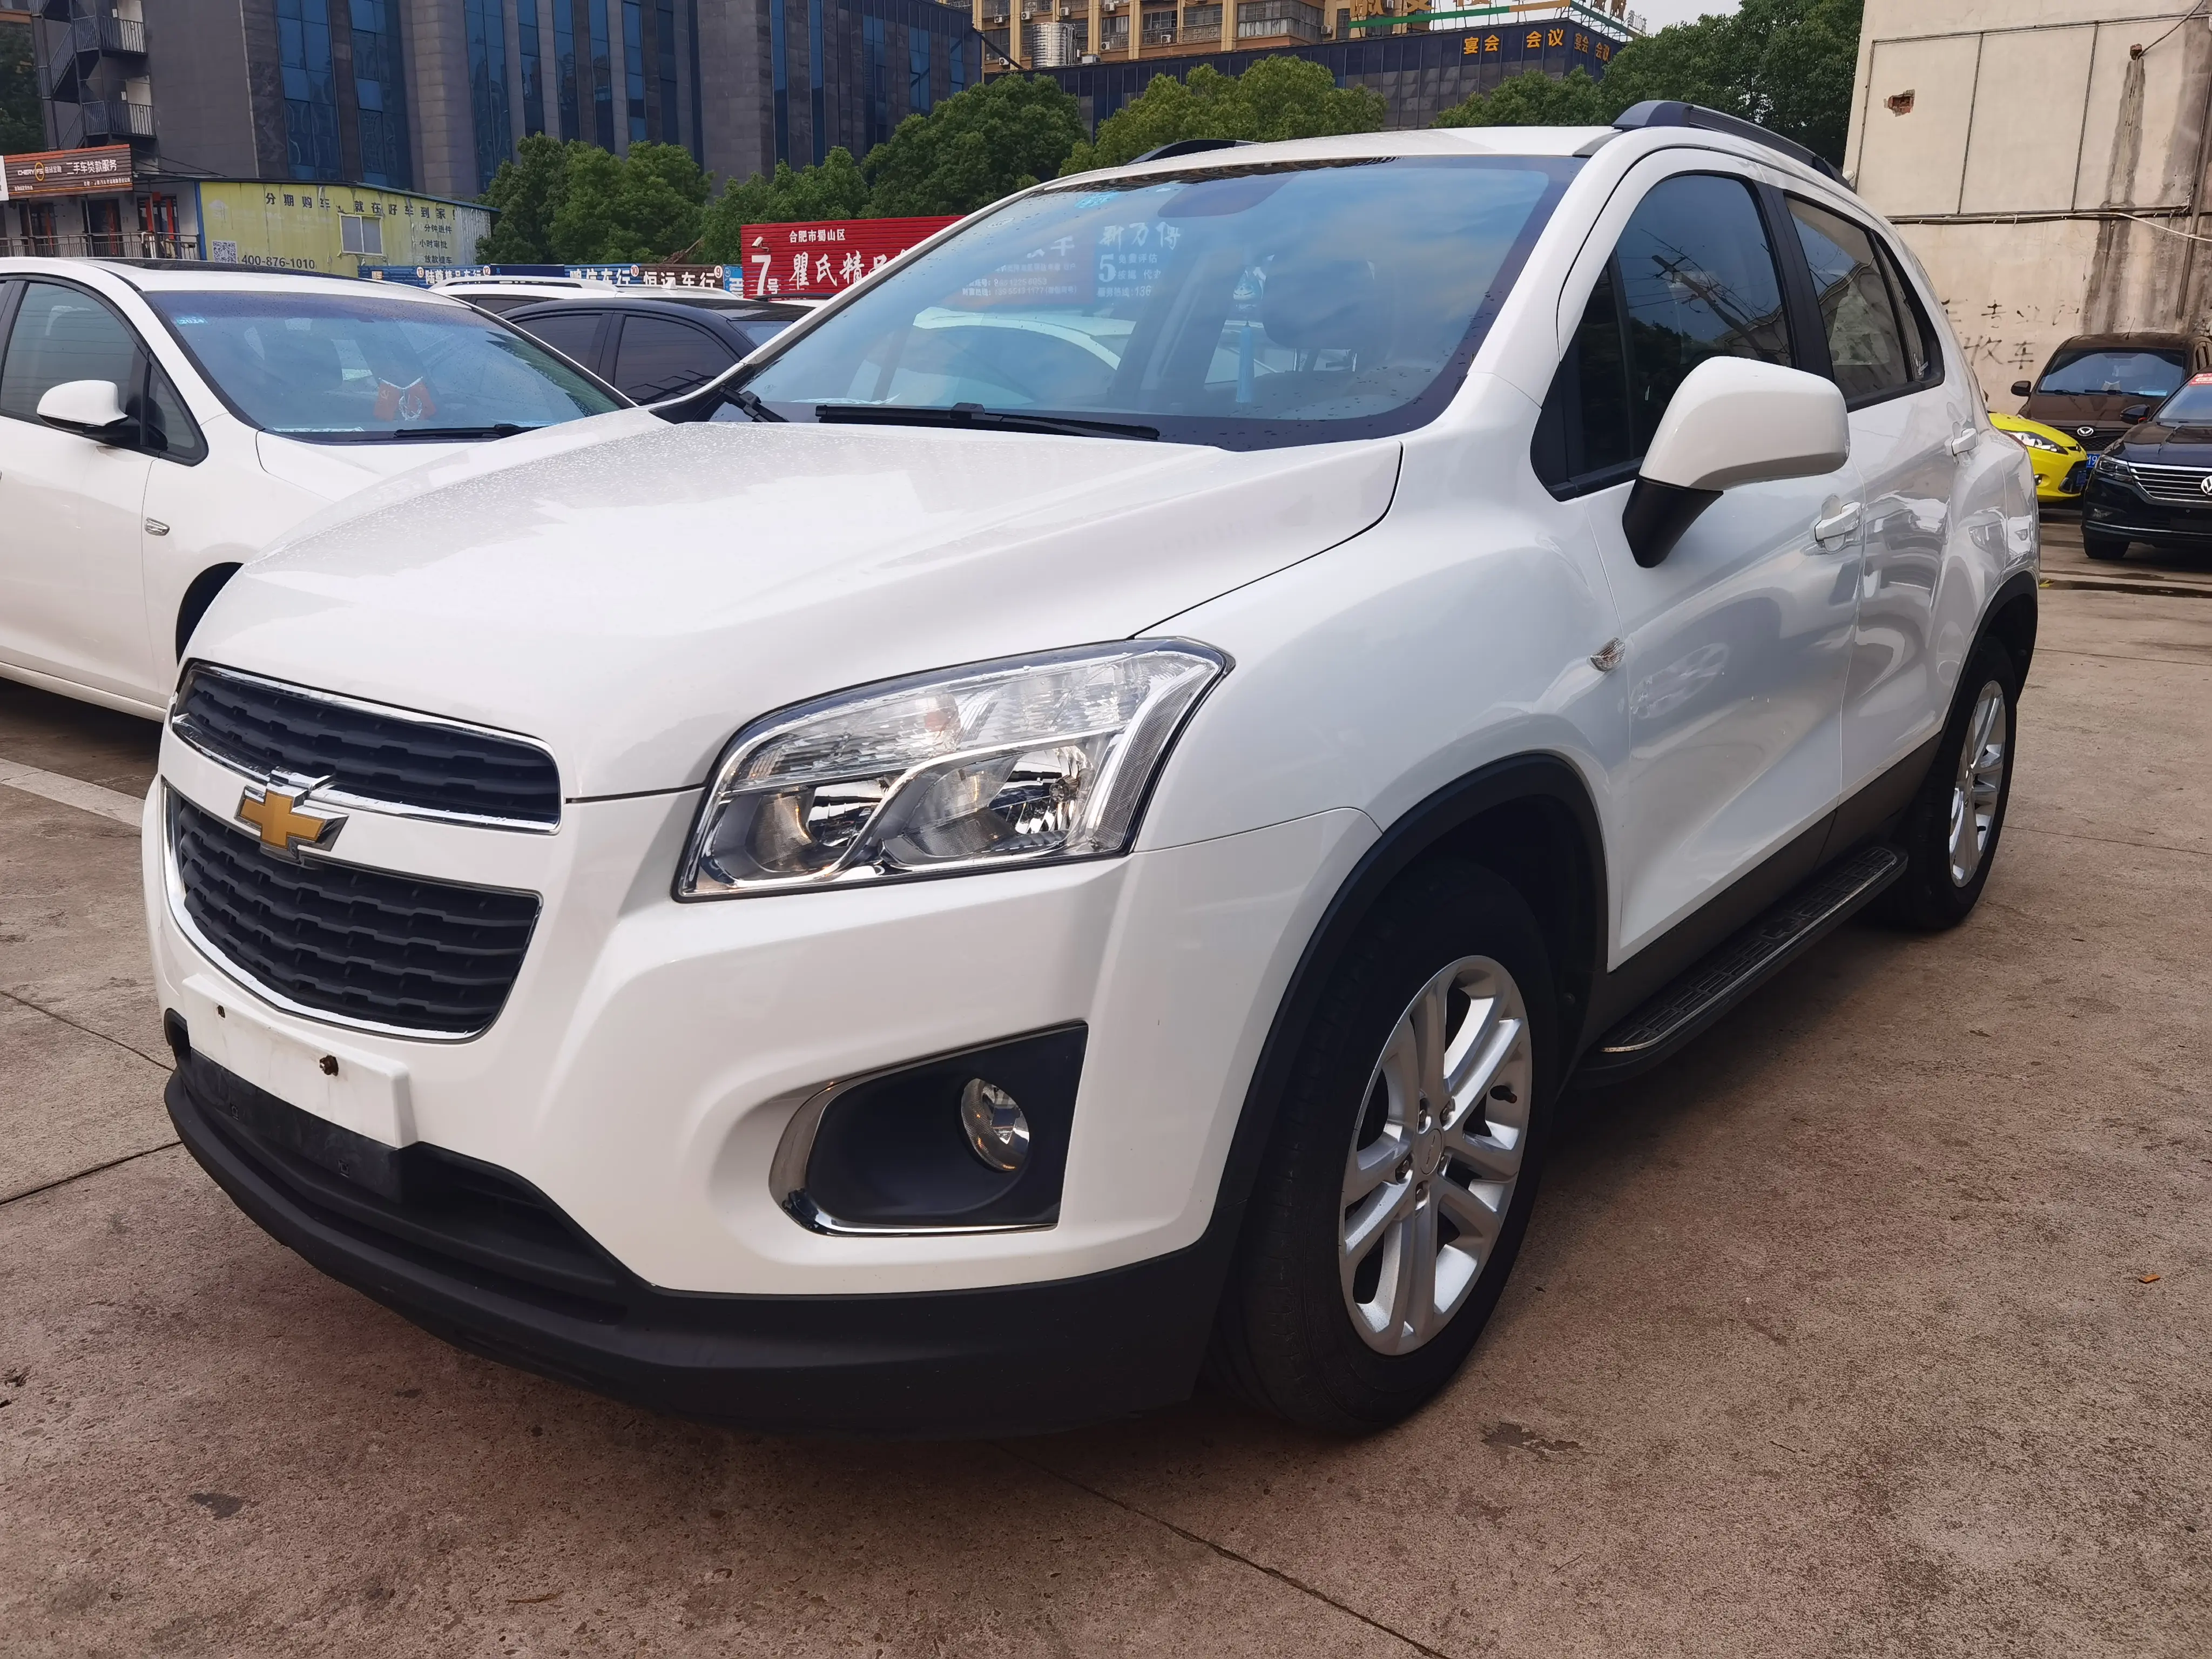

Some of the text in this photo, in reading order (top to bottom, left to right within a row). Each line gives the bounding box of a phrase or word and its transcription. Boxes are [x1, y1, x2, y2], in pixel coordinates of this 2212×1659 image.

[1463, 28, 1564, 55] 宴会 会议
[1574, 33, 1610, 62] 宴会 会议
[66, 159, 117, 174] 二手车贷款服务
[265, 192, 331, 212] 分期购车
[789, 228, 846, 244] 合肥市蜀山区
[241, 254, 315, 269] 400-876-1010
[788, 249, 906, 290] 瞿氏精品
[1098, 253, 1116, 282] 5
[631, 266, 639, 275] 10
[716, 267, 721, 277] 9
[643, 271, 715, 288] 恒运车行
